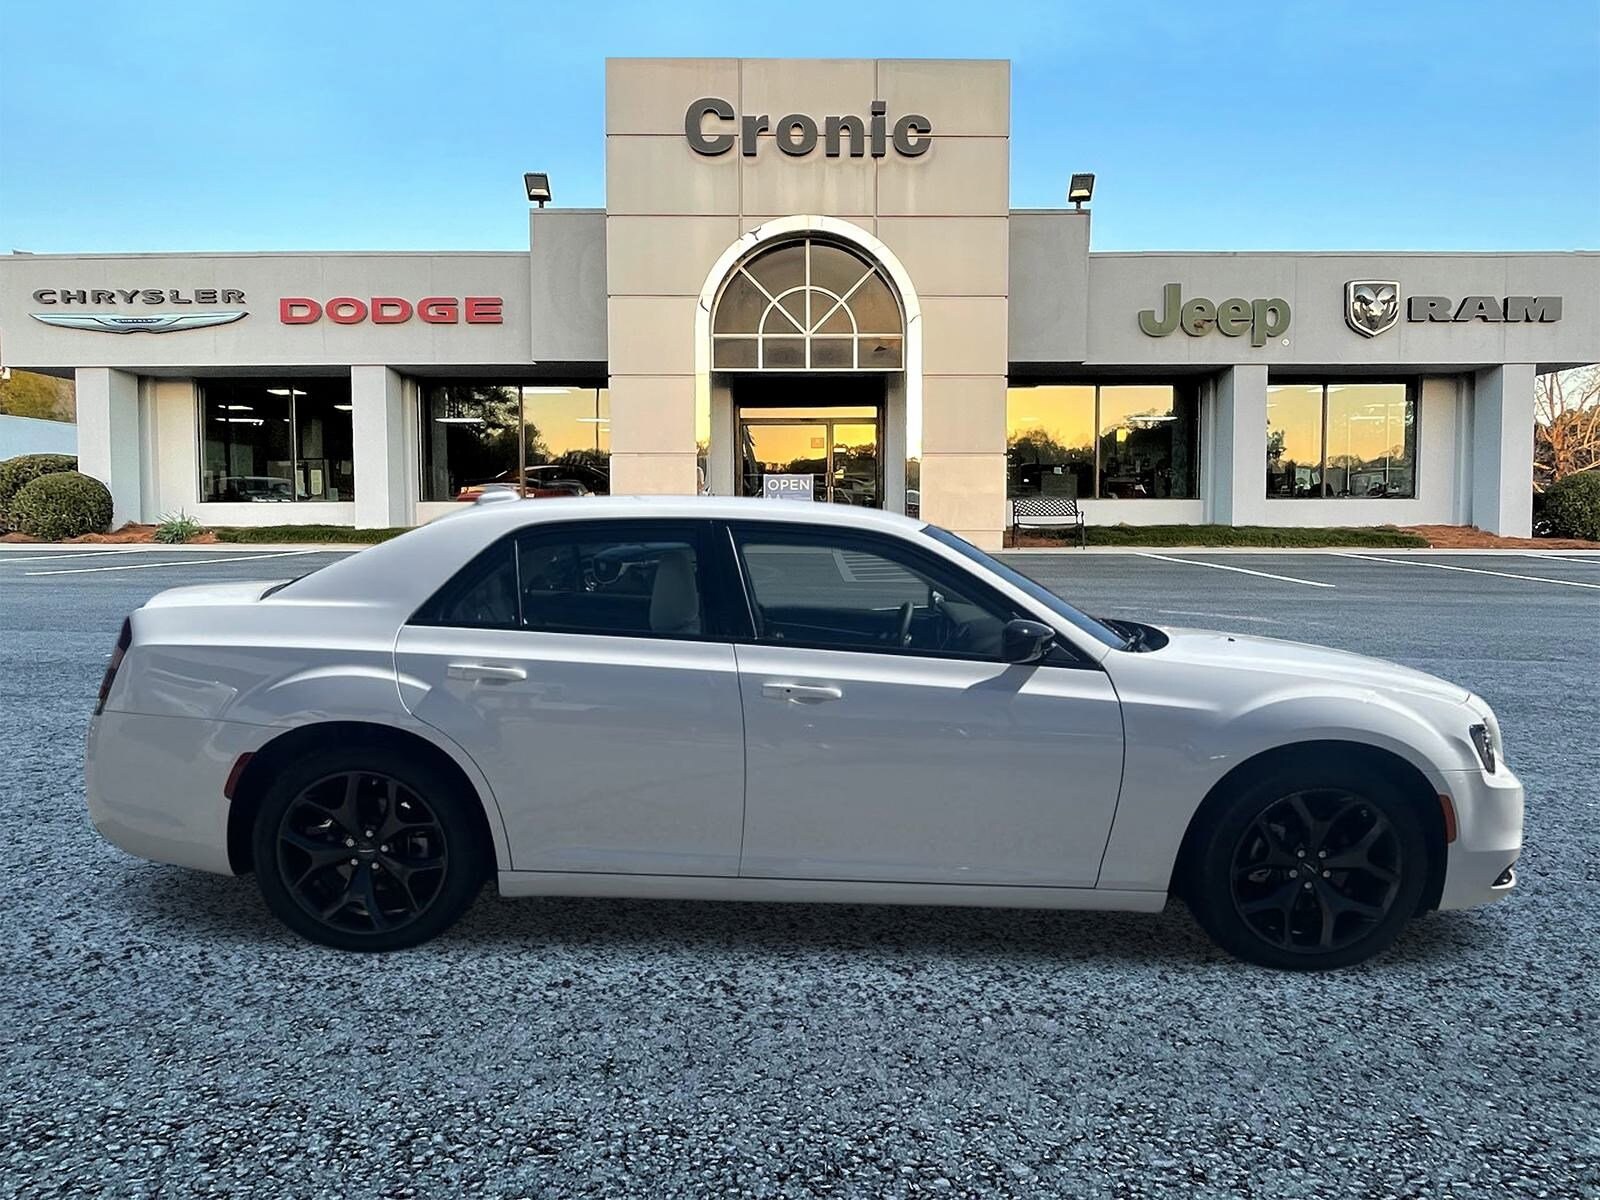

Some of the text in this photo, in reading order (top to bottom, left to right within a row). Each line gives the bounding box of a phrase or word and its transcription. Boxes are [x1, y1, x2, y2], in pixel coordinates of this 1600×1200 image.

[685, 97, 932, 158] Cronic
[32, 288, 248, 305] CHRYSLER
[1407, 296, 1563, 323] RAM
[279, 297, 504, 325] DODGE
[1138, 283, 1292, 347] Jeep
[767, 479, 810, 491] OPEN
